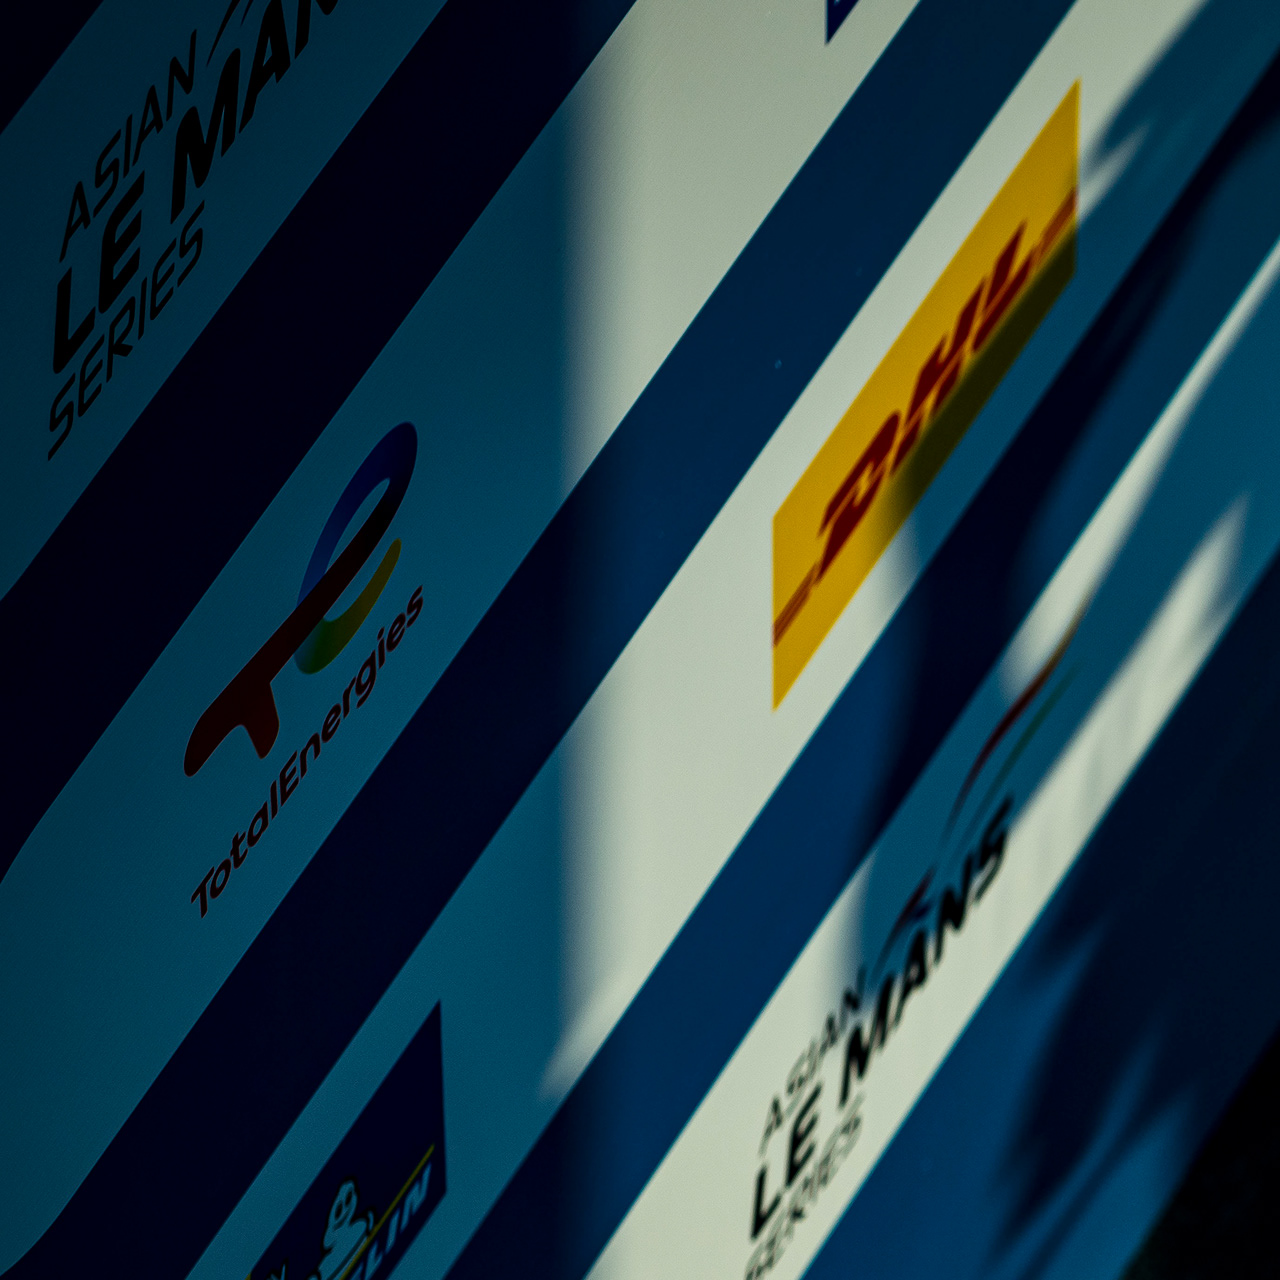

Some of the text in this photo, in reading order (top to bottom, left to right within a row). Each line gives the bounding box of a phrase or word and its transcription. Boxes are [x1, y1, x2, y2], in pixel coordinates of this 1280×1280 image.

[52, 170, 145, 374] LE
[60, 29, 197, 263] ASIAN
[48, 200, 205, 461] SERIES
[815, 219, 1031, 586] DHL
[190, 584, 425, 919] TotalEnergies
[750, 798, 1012, 1240] LE MANS
